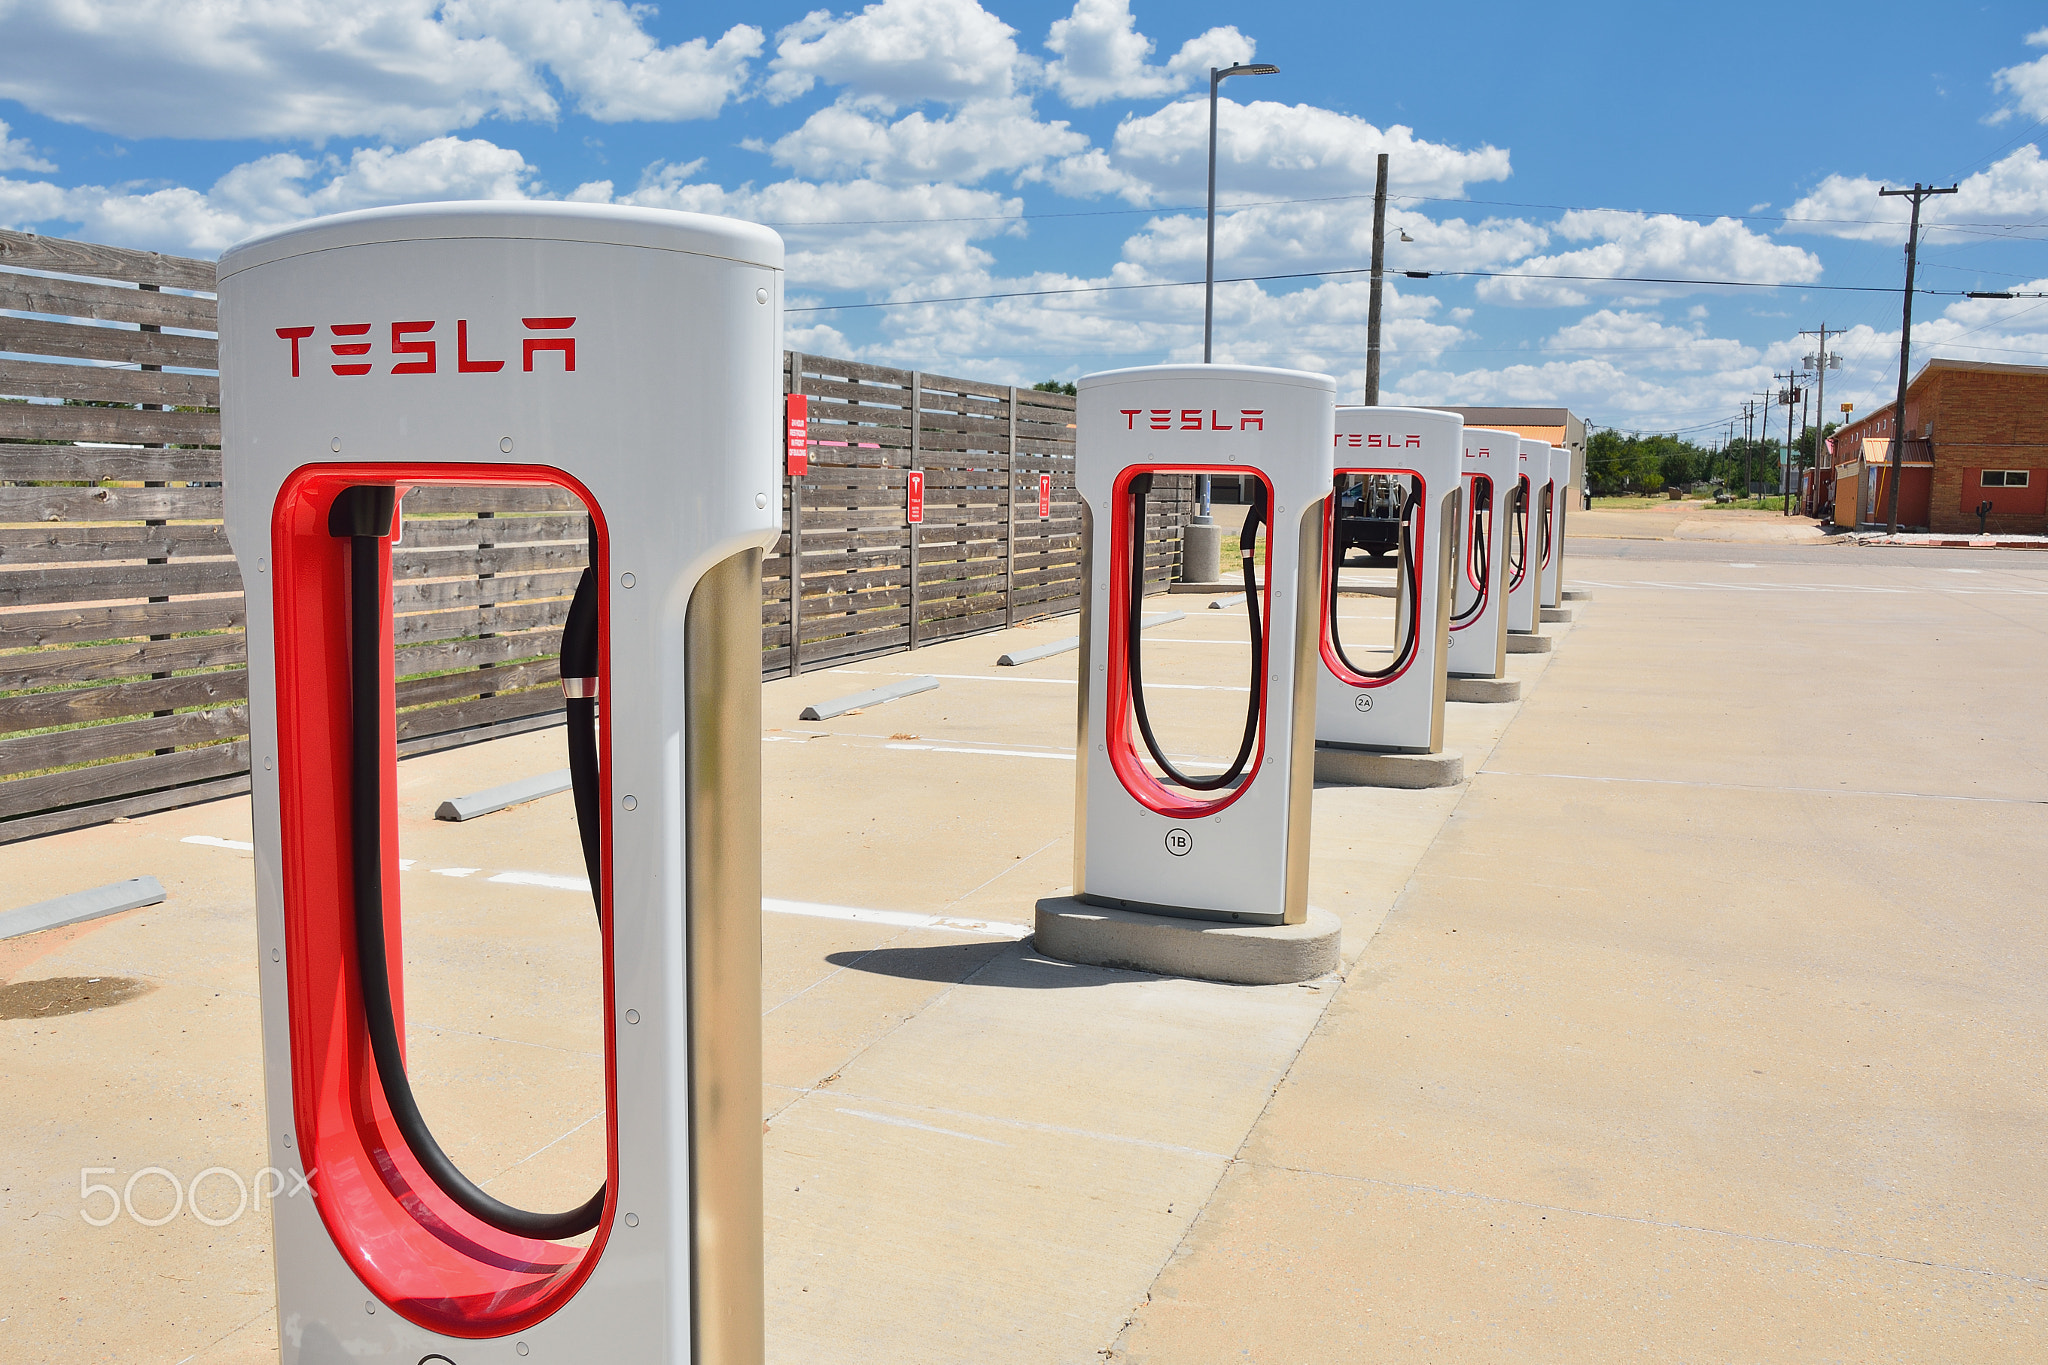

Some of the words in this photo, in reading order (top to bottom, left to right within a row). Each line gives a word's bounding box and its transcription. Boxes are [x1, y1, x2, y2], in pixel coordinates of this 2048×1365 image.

[275, 316, 577, 378] TESLA
[1119, 409, 1264, 431] TESLA
[1358, 698, 1370, 706] 2A
[1171, 836, 1186, 847] 1B
